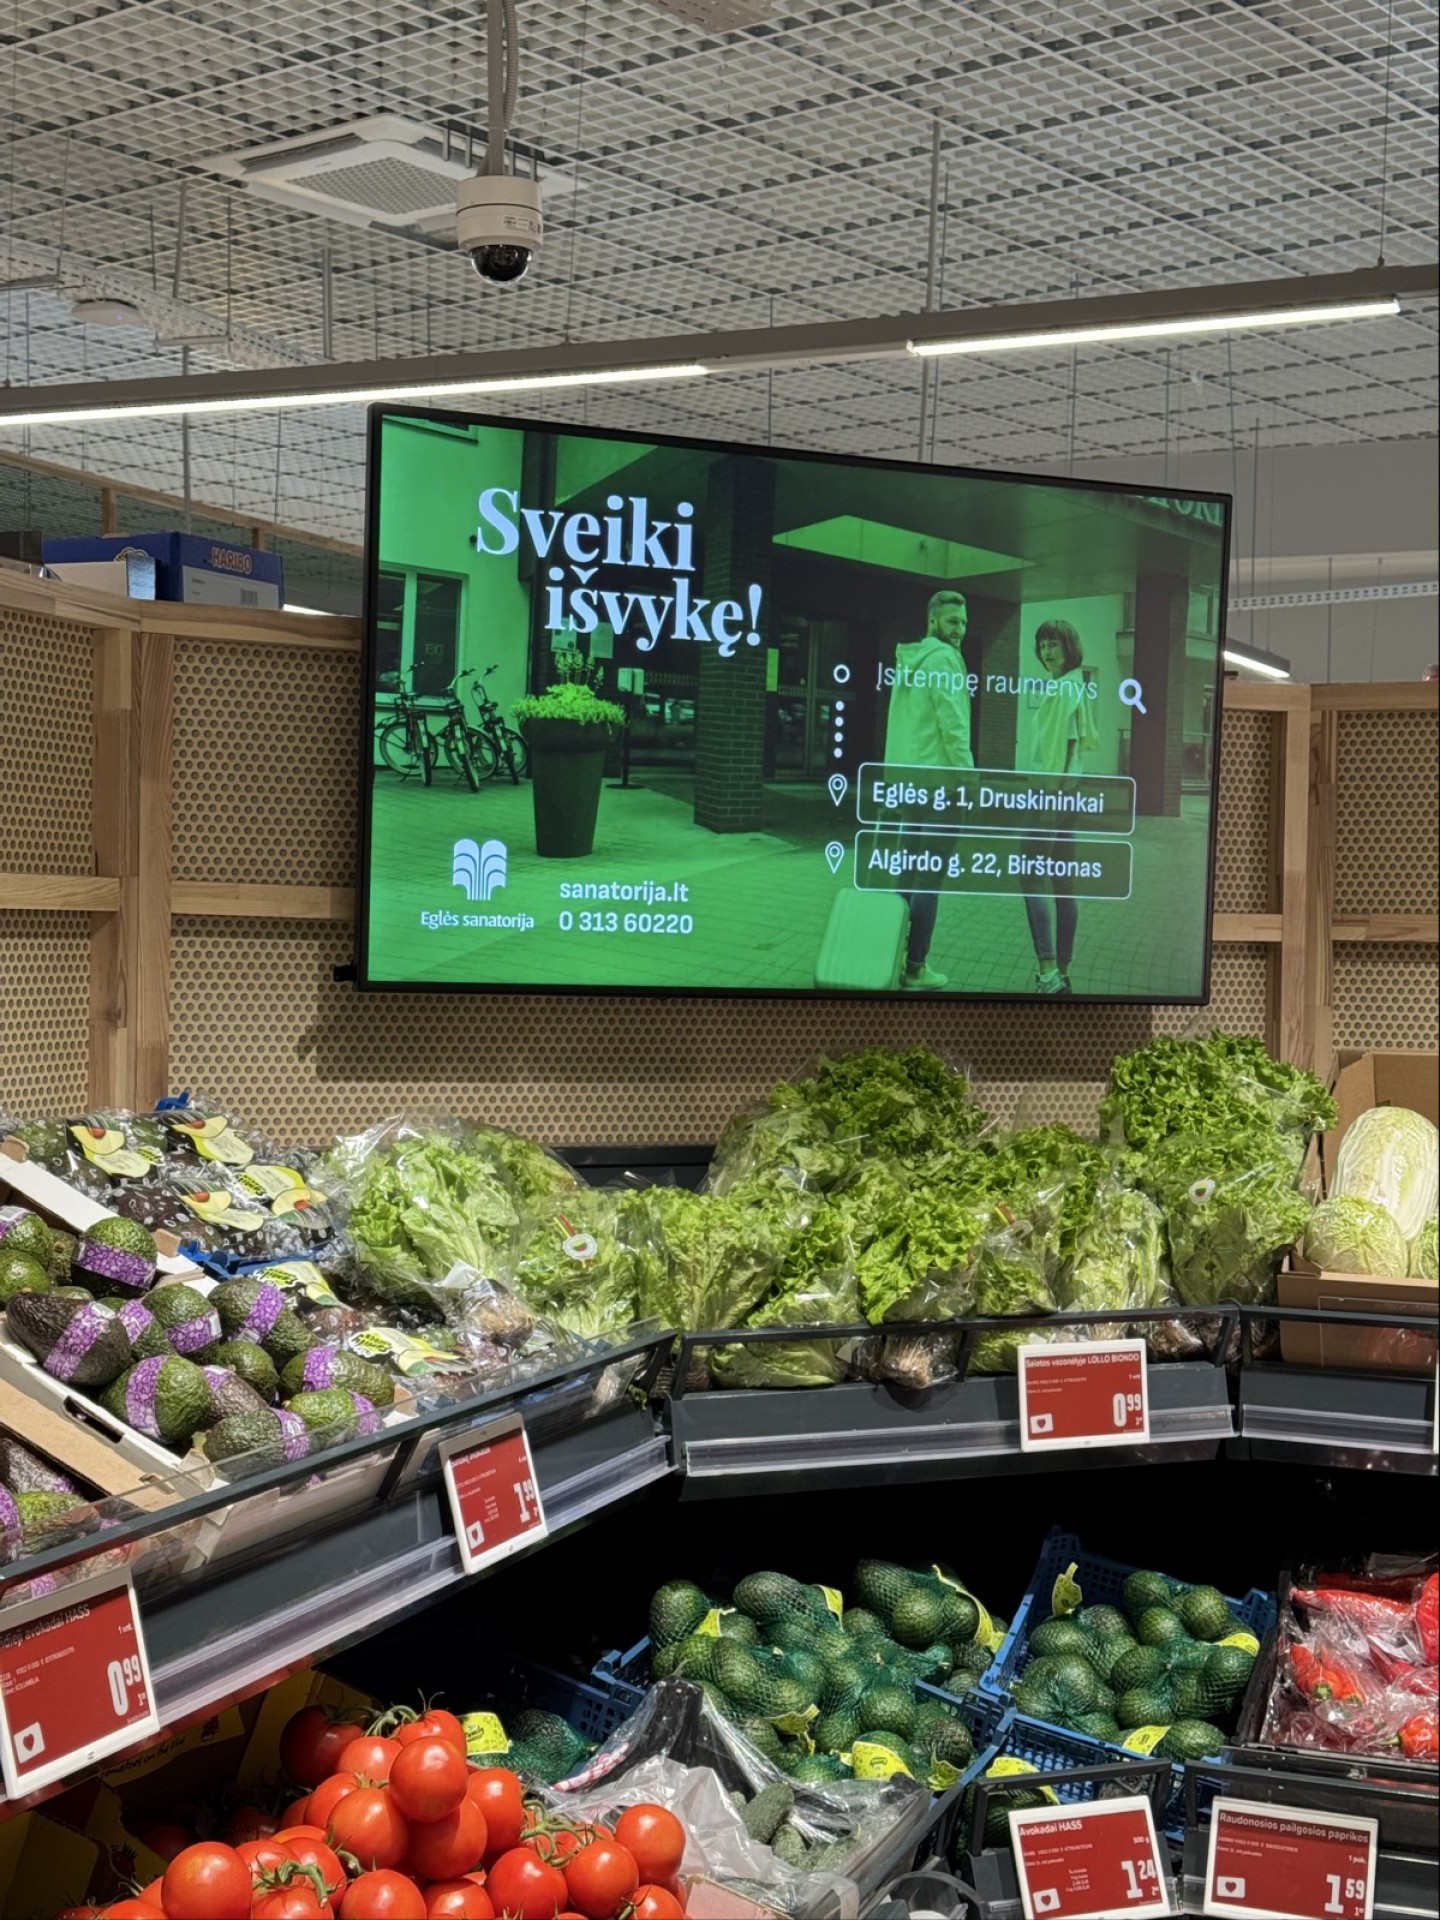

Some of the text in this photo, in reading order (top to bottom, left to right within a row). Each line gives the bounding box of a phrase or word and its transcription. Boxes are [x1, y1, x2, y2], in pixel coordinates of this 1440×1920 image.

[477, 488, 695, 571] Sveiki
[212, 547, 252, 574] HARIBO
[545, 566, 762, 657] išvykę!
[876, 662, 1098, 703] Įsitempę raumenys
[872, 782, 1105, 813] Eglės g. 1, Druskininkai
[868, 849, 1102, 878] Algirdo g. 22, Birštonas
[559, 880, 689, 905] sanatorija.lt
[421, 911, 535, 932] Eglės sanatorija
[559, 911, 693, 934] 0 313 60220
[1087, 1355, 1110, 1365] LOLLO
[1111, 1353, 1140, 1363] BIONDO
[0, 1604, 91, 1649] idieji avokadai HASS
[1019, 1820, 1083, 1837] Avokadai HASS
[1219, 1812, 1369, 1844] Raudonosios pailgosios paprikos
